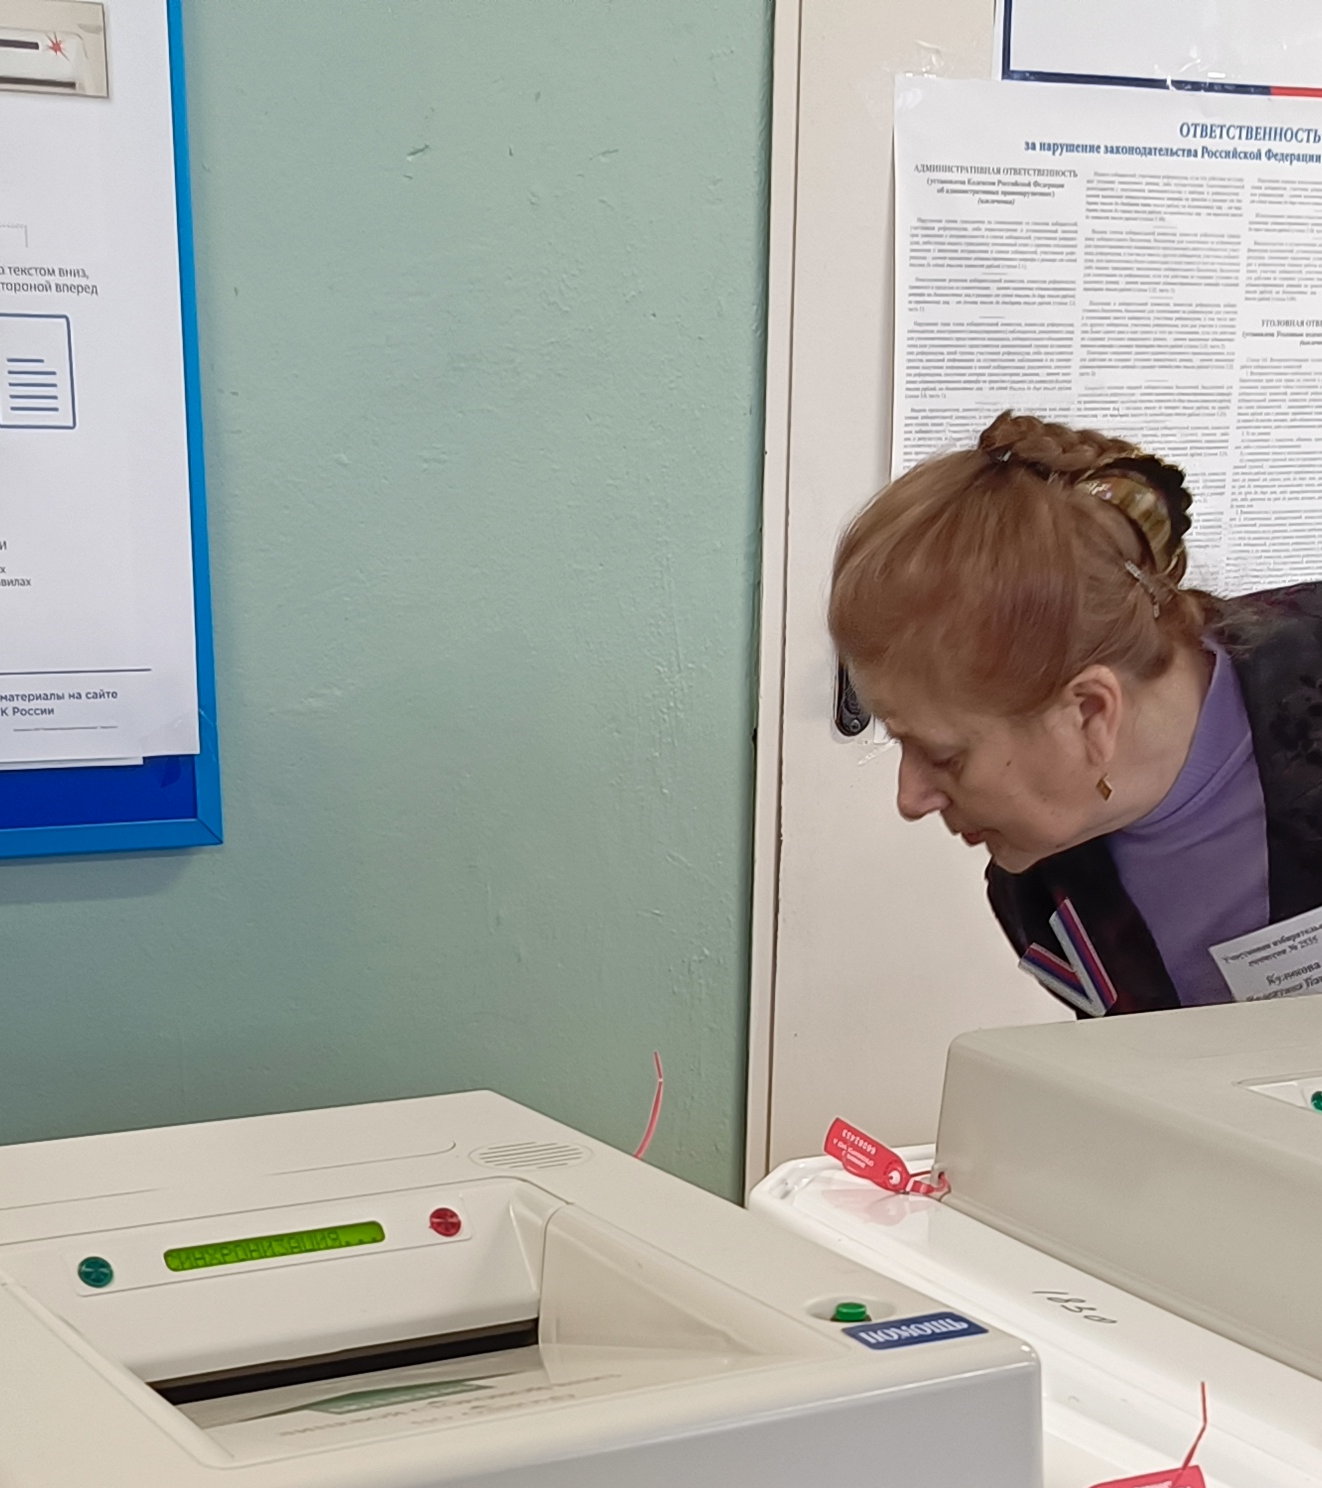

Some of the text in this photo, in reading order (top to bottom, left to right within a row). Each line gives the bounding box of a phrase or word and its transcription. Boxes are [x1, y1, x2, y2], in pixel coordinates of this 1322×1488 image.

[1179, 122, 1322, 144] ОТВЕТСТВЕННОСТЬ
[1025, 140, 1036, 150] за
[1039, 141, 1100, 156] нарушение
[1103, 144, 1197, 160] законодательства
[1201, 145, 1261, 160] Российской
[1265, 147, 1321, 166] Федерации
[8, 265, 56, 277] текстом
[59, 267, 89, 279] вниз,
[55, 283, 98, 296] вперед
[0, 692, 64, 704] материалы
[68, 691, 81, 700] на
[85, 689, 118, 699] сайте
[12, 705, 55, 716] России
[859, 1318, 969, 1344] ПОМОЩЬ
